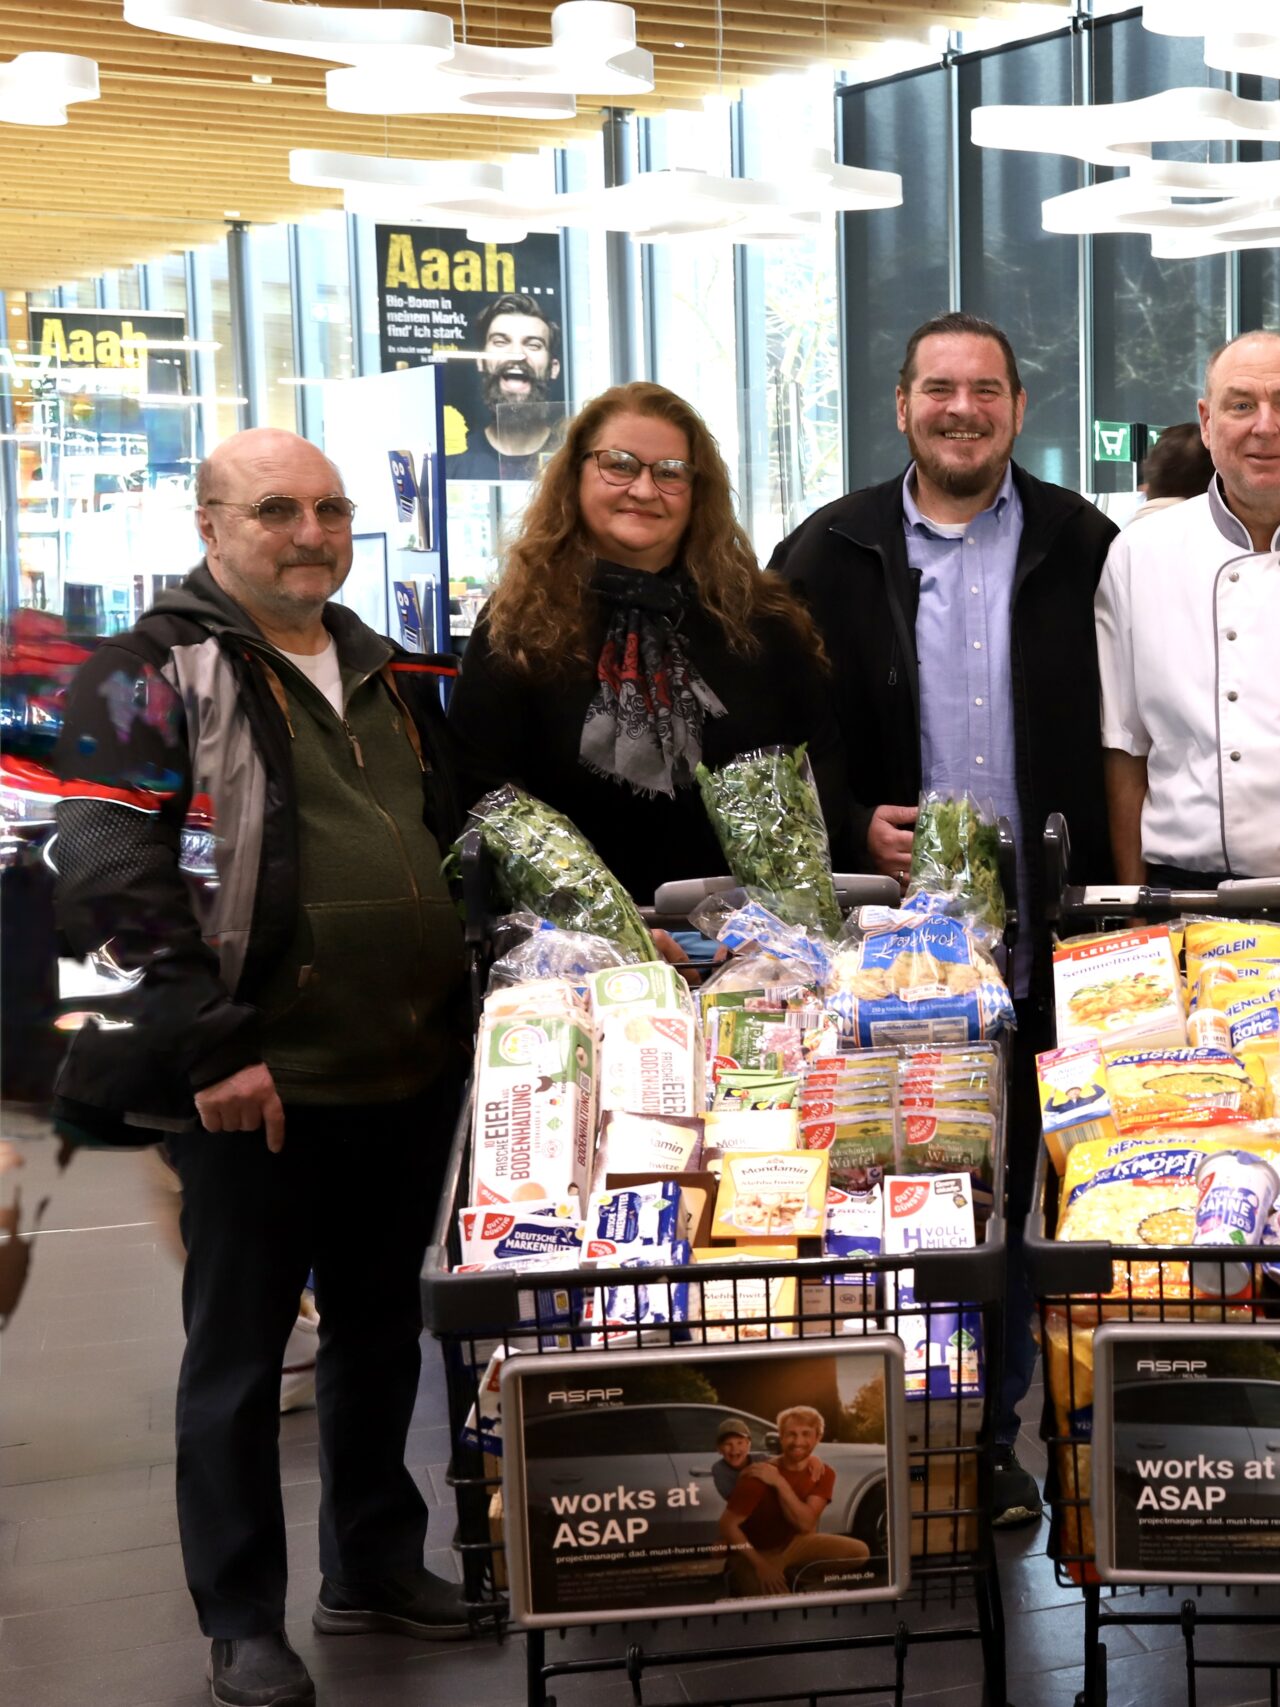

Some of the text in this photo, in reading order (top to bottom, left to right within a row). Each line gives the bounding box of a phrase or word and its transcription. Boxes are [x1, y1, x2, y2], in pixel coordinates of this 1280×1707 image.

[386, 294, 452, 309] Bio-Boom in
[387, 311, 468, 326] meinem Markt,
[414, 327, 431, 337] ich
[433, 328, 465, 339] stark.
[1080, 938, 1140, 957] LEIMER
[662, 1082, 687, 1114] EIER
[485, 1101, 509, 1140] EIER
[510, 1084, 532, 1180] BODENHALTUNG
[577, 1092, 591, 1167] BODENHALTUNG
[485, 1138, 495, 1148] 10
[496, 1139, 508, 1177] FRISCHE
[829, 1153, 876, 1169] Würfel
[928, 1150, 974, 1165] Würfel
[741, 1164, 808, 1175] Mondamin
[1200, 1195, 1252, 1217] SAHNE
[514, 1231, 558, 1243] DEUTSCHE
[903, 1227, 966, 1249] H VOLL-
[926, 1237, 968, 1249] MILCH
[704, 1292, 772, 1300] Mehlshwitze
[1137, 1360, 1208, 1372] ASAP
[548, 1388, 624, 1403] ASAP
[950, 1385, 980, 1393] EEKA
[1135, 1455, 1276, 1480] works at
[552, 1481, 700, 1515] works at
[1136, 1485, 1227, 1511] ASAP
[1138, 1517, 1204, 1527] projectmanager.
[1206, 1517, 1224, 1525] dad.
[1226, 1517, 1269, 1526] must-have
[552, 1517, 649, 1549] ASAP
[556, 1542, 754, 1564] projectmanager. dad. must-have remote work.
[824, 1570, 876, 1583] join.asap.de
